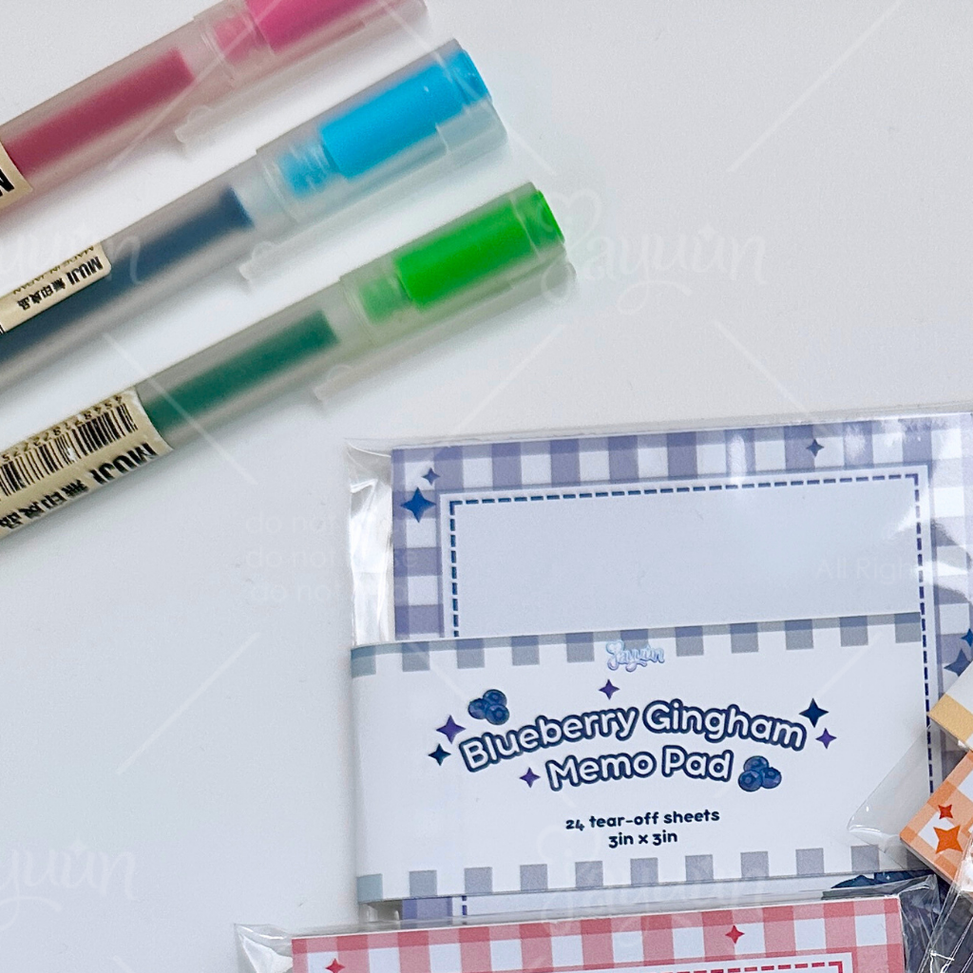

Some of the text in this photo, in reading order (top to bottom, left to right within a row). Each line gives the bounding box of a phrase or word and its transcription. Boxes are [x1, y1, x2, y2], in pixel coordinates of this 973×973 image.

[17, 255, 104, 311] MUJI 無印良品
[0, 441, 160, 530] MUJI 無印良品
[458, 698, 808, 773] Blueberry Gingham
[545, 744, 734, 792] Memo Pad
[565, 808, 721, 832] 24 tear-off sheets
[608, 828, 678, 848] 3in x 3in
